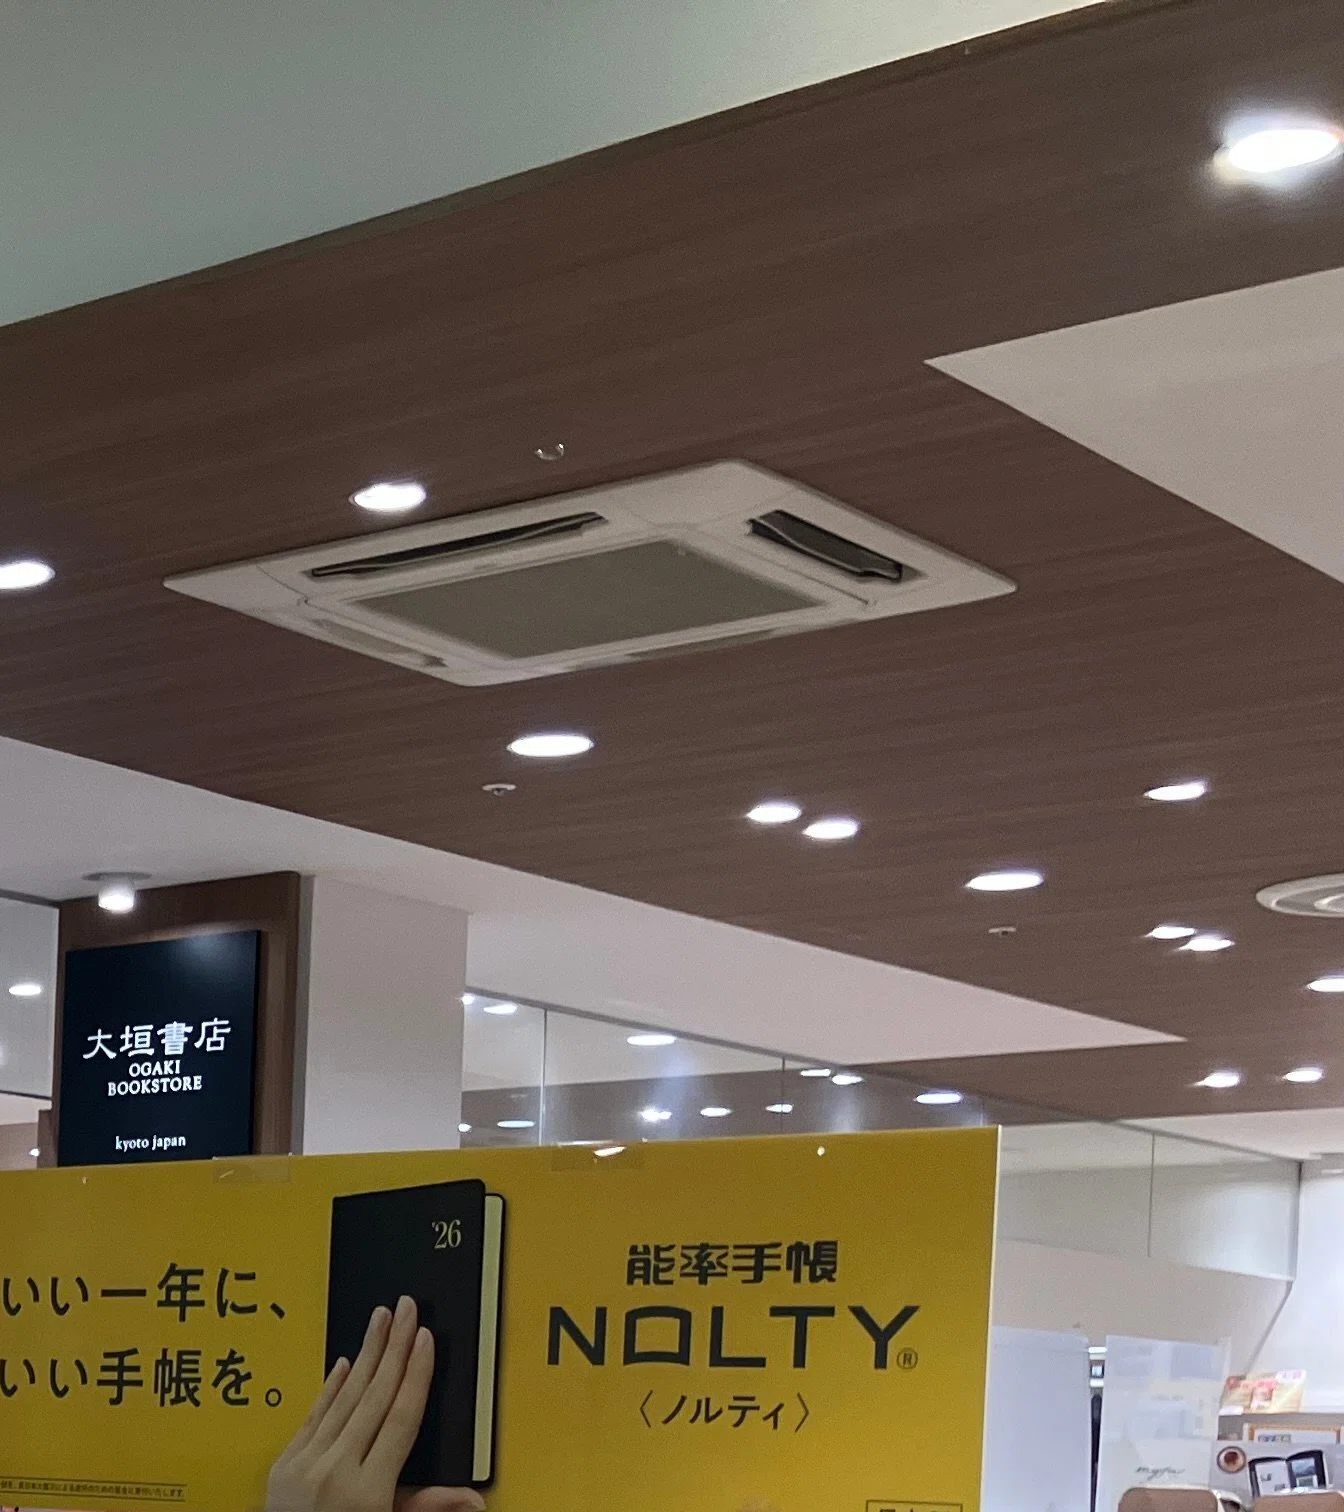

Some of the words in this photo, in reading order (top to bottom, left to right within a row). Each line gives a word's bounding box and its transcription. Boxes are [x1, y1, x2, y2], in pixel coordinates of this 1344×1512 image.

[83, 1016, 231, 1061] 大垣書店
[107, 1074, 203, 1097] BOOKSTORE
[128, 1059, 181, 1077] OGAKI
[115, 1135, 150, 1152] kyoto
[151, 1134, 187, 1151] japan
[625, 1239, 840, 1286] 能率手帳
[1, 1262, 288, 1324] いい一年に、
[546, 1303, 922, 1371] NOLTY
